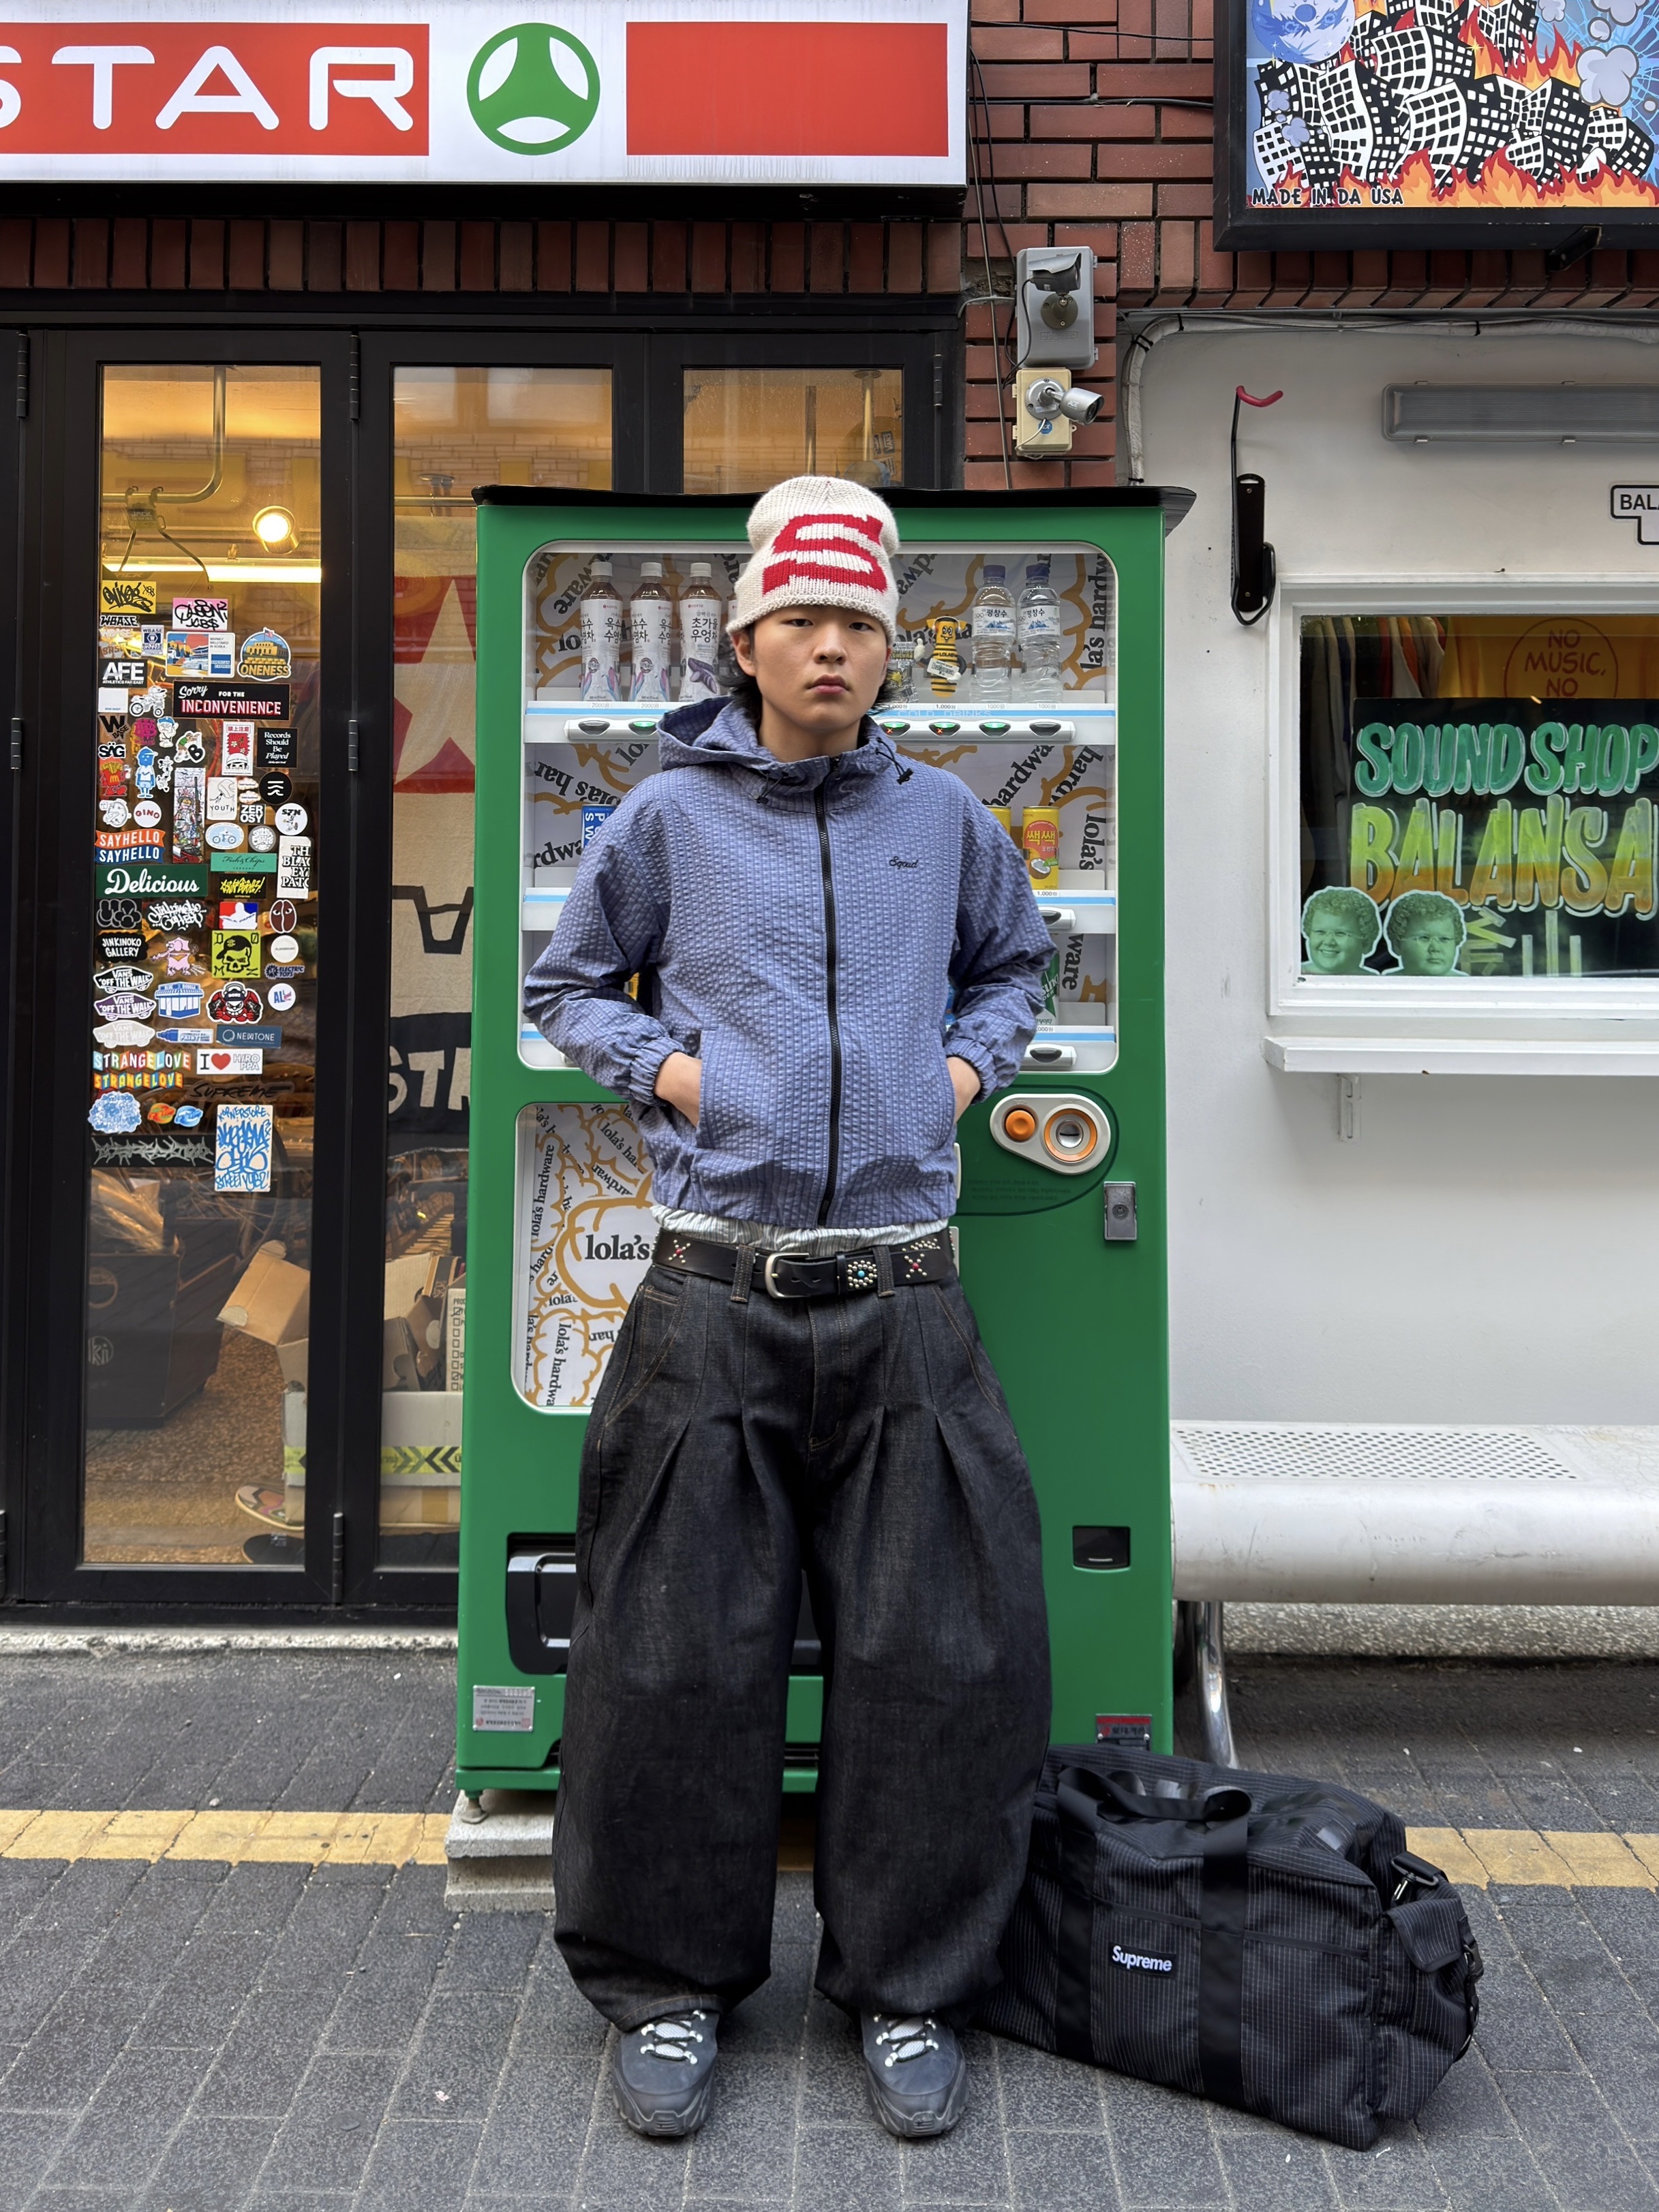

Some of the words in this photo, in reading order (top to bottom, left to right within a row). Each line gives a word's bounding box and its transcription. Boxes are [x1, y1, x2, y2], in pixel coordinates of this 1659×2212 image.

[0, 46, 414, 130] TAR
[1251, 187, 1302, 205] MADE
[1309, 187, 1328, 205] IN
[1338, 187, 1363, 205] DA
[1371, 187, 1404, 205] USA
[1620, 494, 1659, 510] BAL
[986, 609, 1008, 618] 평창수
[1026, 608, 1046, 619] 평창수
[691, 617, 718, 630] 초가을
[1548, 629, 1581, 649] NO
[102, 662, 144, 681] AFE
[240, 664, 290, 676] ONENESS
[178, 685, 209, 699] Sorry
[1545, 677, 1579, 698] NO
[181, 699, 281, 716] INCONVENIENCE
[265, 752, 290, 761] Played
[1354, 722, 1526, 797] SOUND
[1524, 722, 1659, 797] SHOP
[241, 805, 264, 814] ZER
[240, 814, 264, 823] OSY
[100, 831, 160, 847] SAYHELLO
[1026, 831, 1056, 846] 쌕쌕
[99, 846, 159, 863] SAYHELLO
[290, 845, 311, 857] TH
[1350, 794, 1659, 921] BALANSA
[104, 868, 200, 895] Delicious
[102, 938, 142, 947] JINKINOKO
[105, 947, 140, 957] GALLERY
[112, 968, 134, 979] VANS
[115, 977, 130, 987] THE
[113, 995, 135, 1005] VANS
[115, 1004, 131, 1015] THE
[112, 1023, 133, 1032] VANS
[115, 1031, 130, 1041] THE
[237, 1032, 275, 1041] NEWTONE
[94, 1053, 191, 1069] STRANGELOVE
[94, 1073, 183, 1088] STRANGELOVE
[584, 1234, 650, 1261] lola's
[546, 1357, 566, 1407] hardwa
[1112, 1945, 1172, 1971] Supreme
